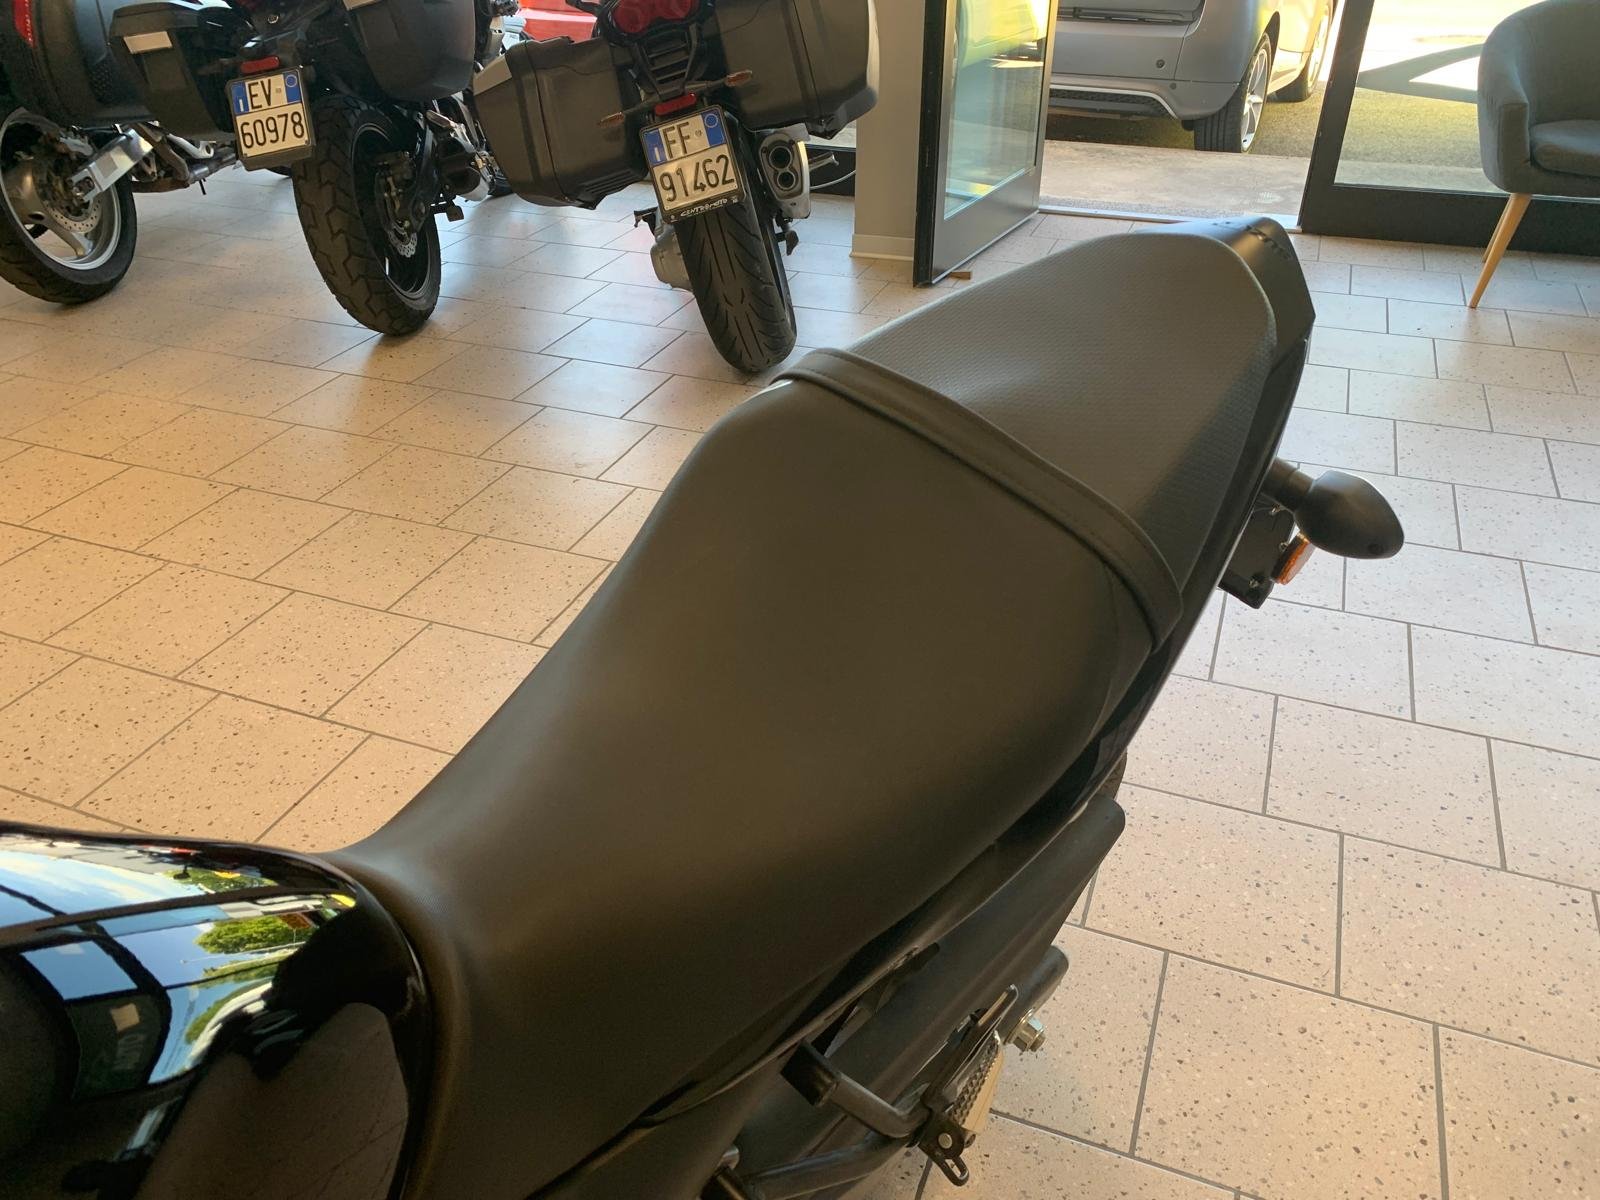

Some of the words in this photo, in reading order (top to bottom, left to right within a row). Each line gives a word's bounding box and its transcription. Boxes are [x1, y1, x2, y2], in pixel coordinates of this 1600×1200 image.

[247, 78, 272, 110] EV
[240, 111, 305, 149] 60978
[661, 121, 690, 158] FF
[659, 154, 735, 202] 91462
